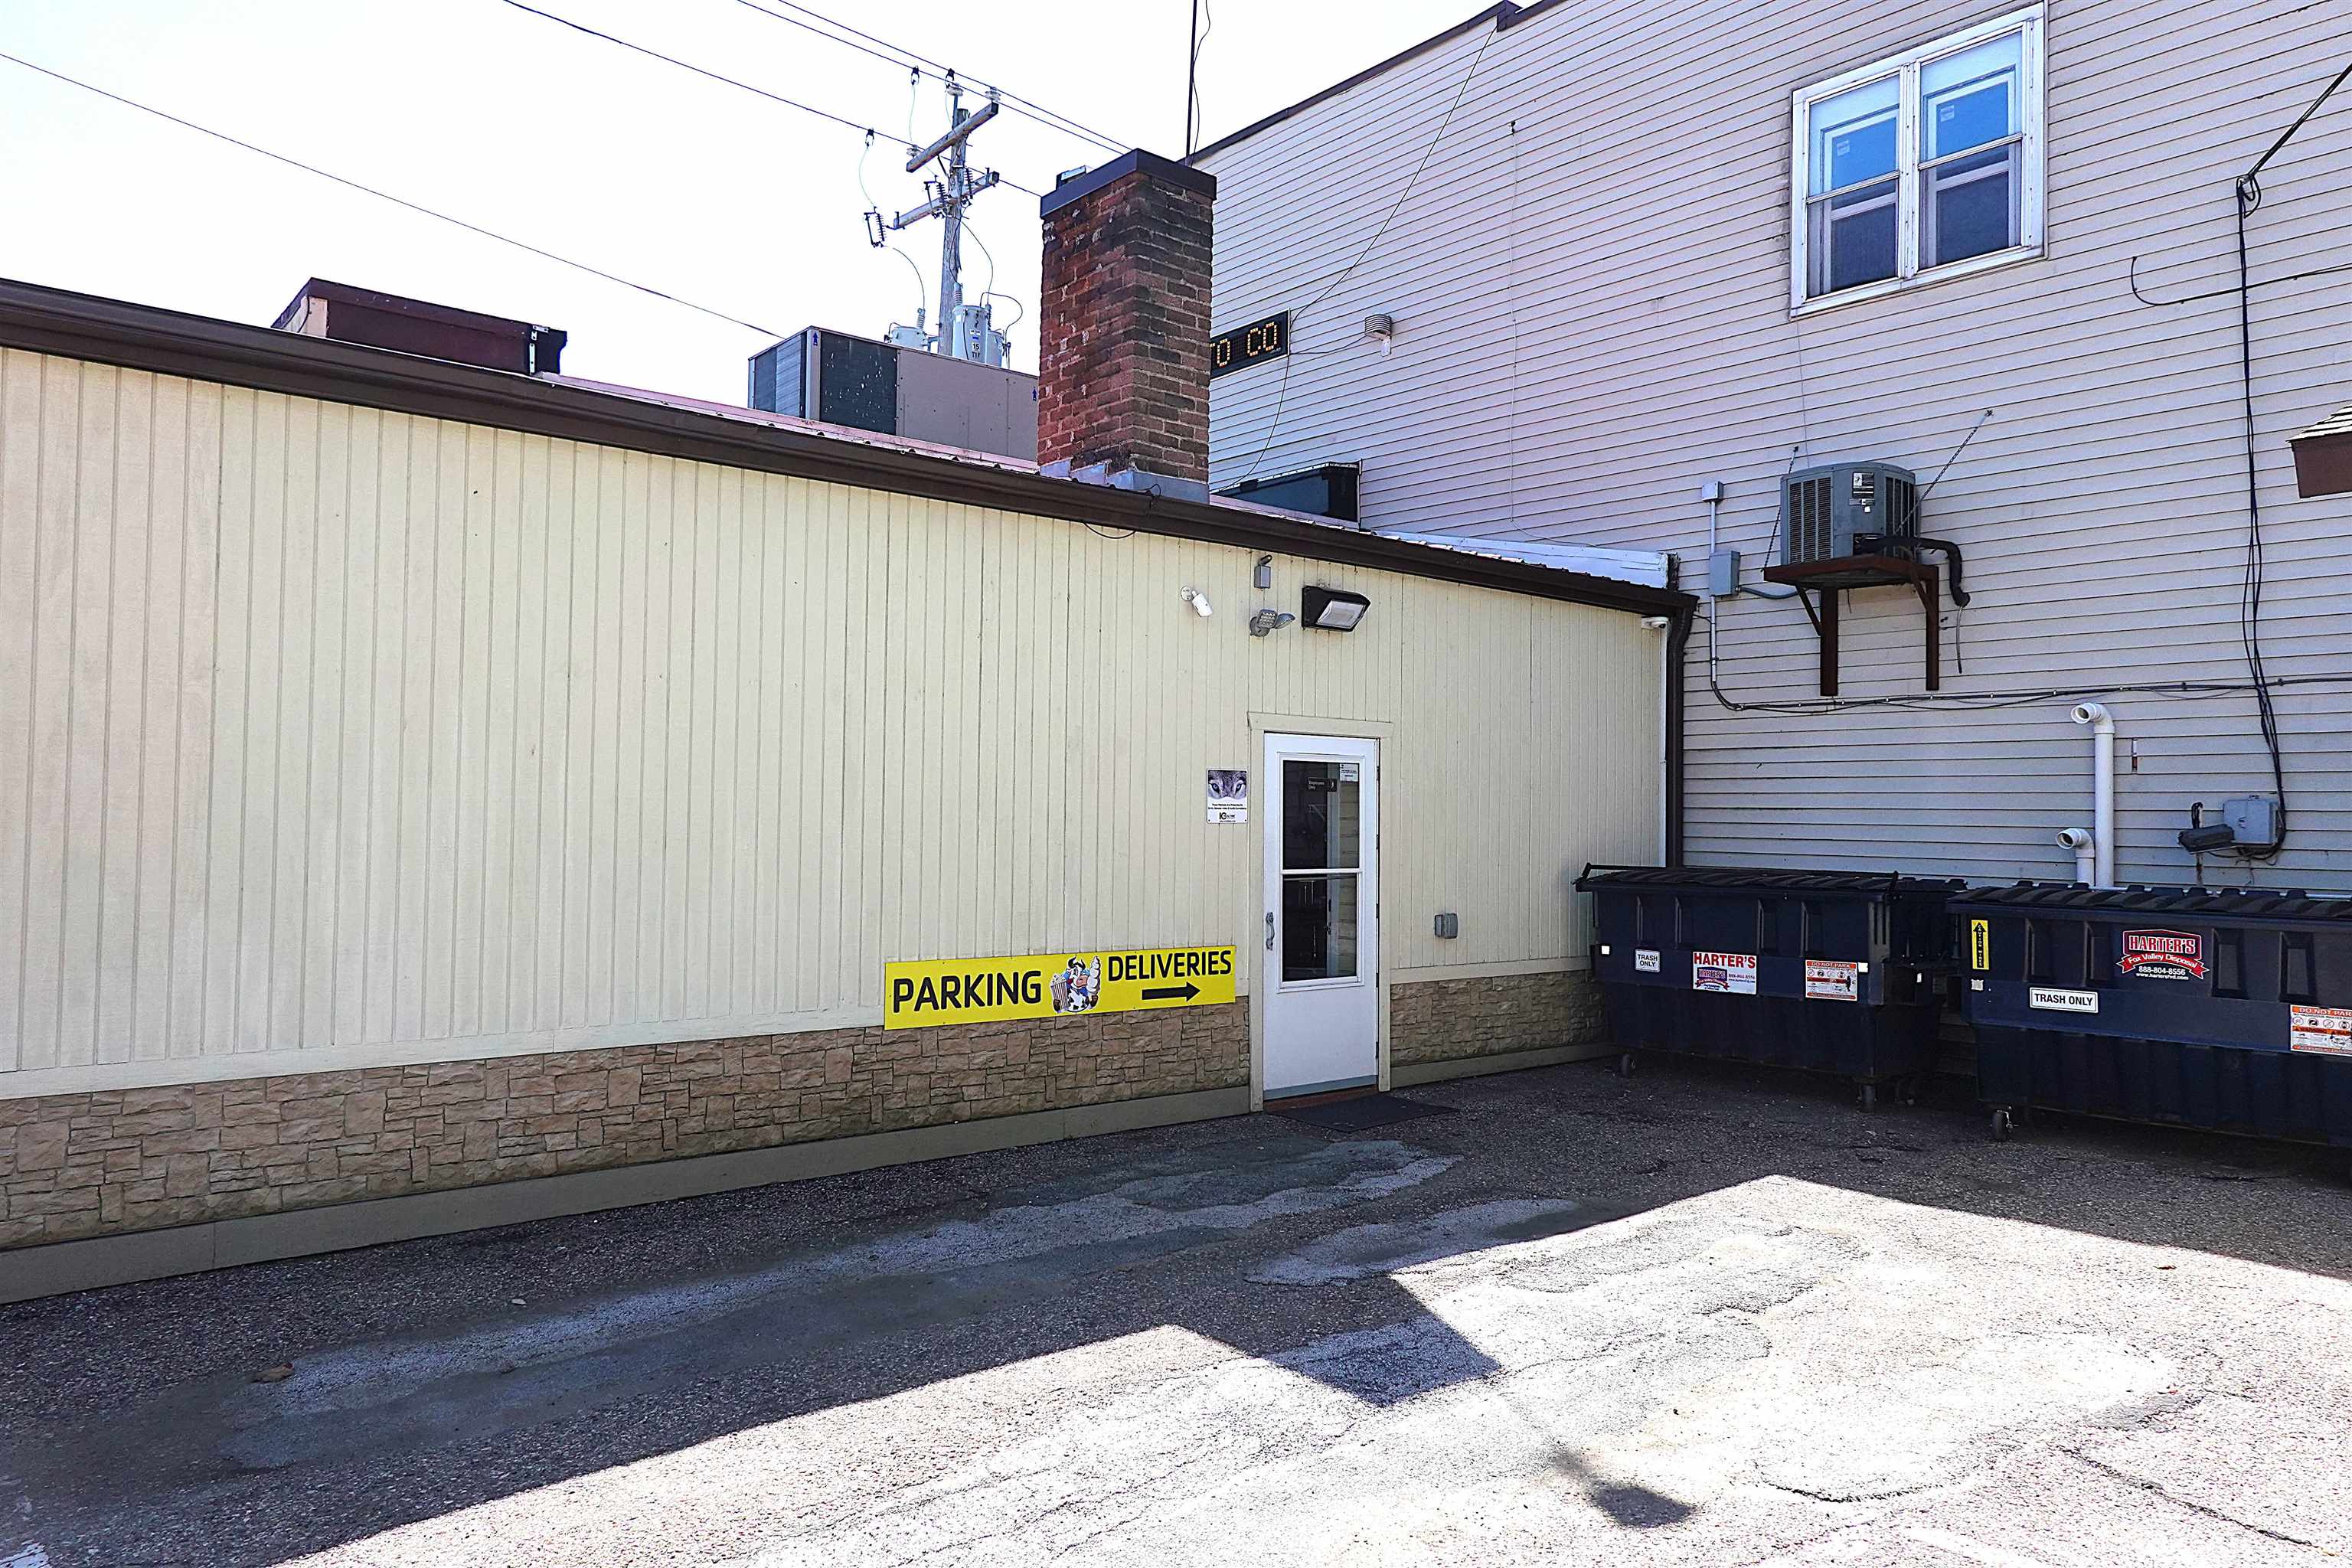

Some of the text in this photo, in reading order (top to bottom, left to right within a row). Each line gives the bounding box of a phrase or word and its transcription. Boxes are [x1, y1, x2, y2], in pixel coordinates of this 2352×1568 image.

[2128, 935, 2196, 955] HARTER'S
[1108, 950, 1232, 982] DELIVERIES
[1694, 952, 1756, 969] HARTER'S
[2128, 952, 2198, 969] Fox Valley Disposal
[893, 971, 1042, 1014] PARKING
[2034, 993, 2093, 1006] TRASH ONLY
